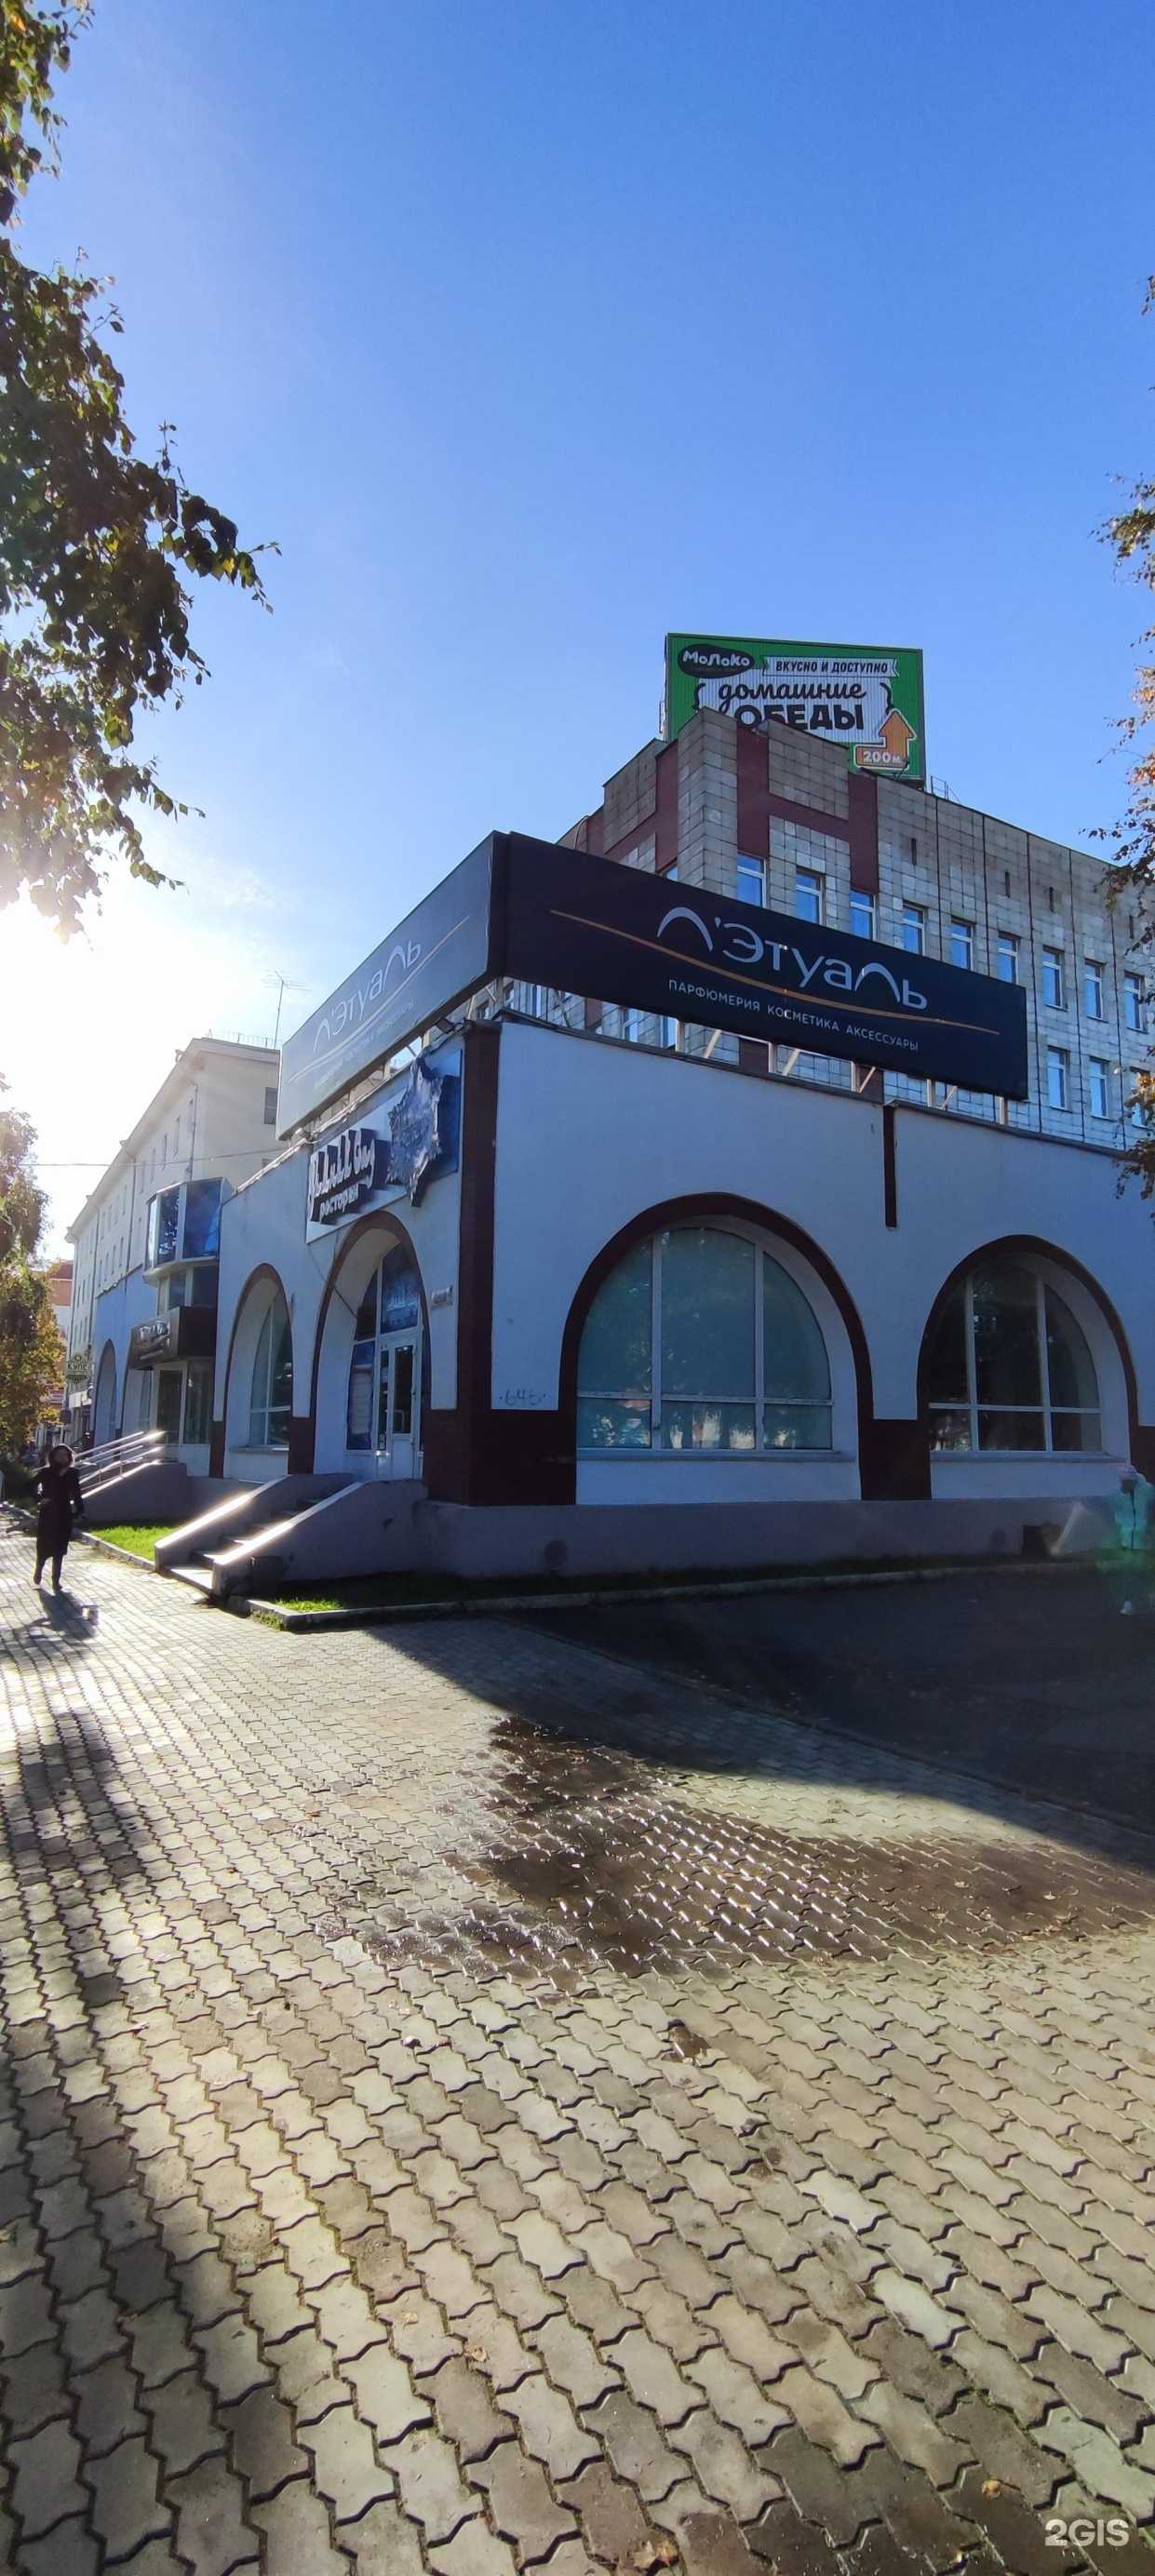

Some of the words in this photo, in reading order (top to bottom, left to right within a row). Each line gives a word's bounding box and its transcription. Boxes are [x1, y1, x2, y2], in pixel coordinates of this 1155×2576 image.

[775, 661, 818, 672] ВКУСНО
[821, 661, 829, 673] И
[831, 662, 888, 675] ДОСТУПНО
[718, 682, 867, 715] домашние
[668, 979, 760, 1013] ПАРФЮМЕРИЯ
[767, 1004, 839, 1032] КОСМЕТИКА
[845, 1025, 920, 1051] АКСЕССУАРЫ
